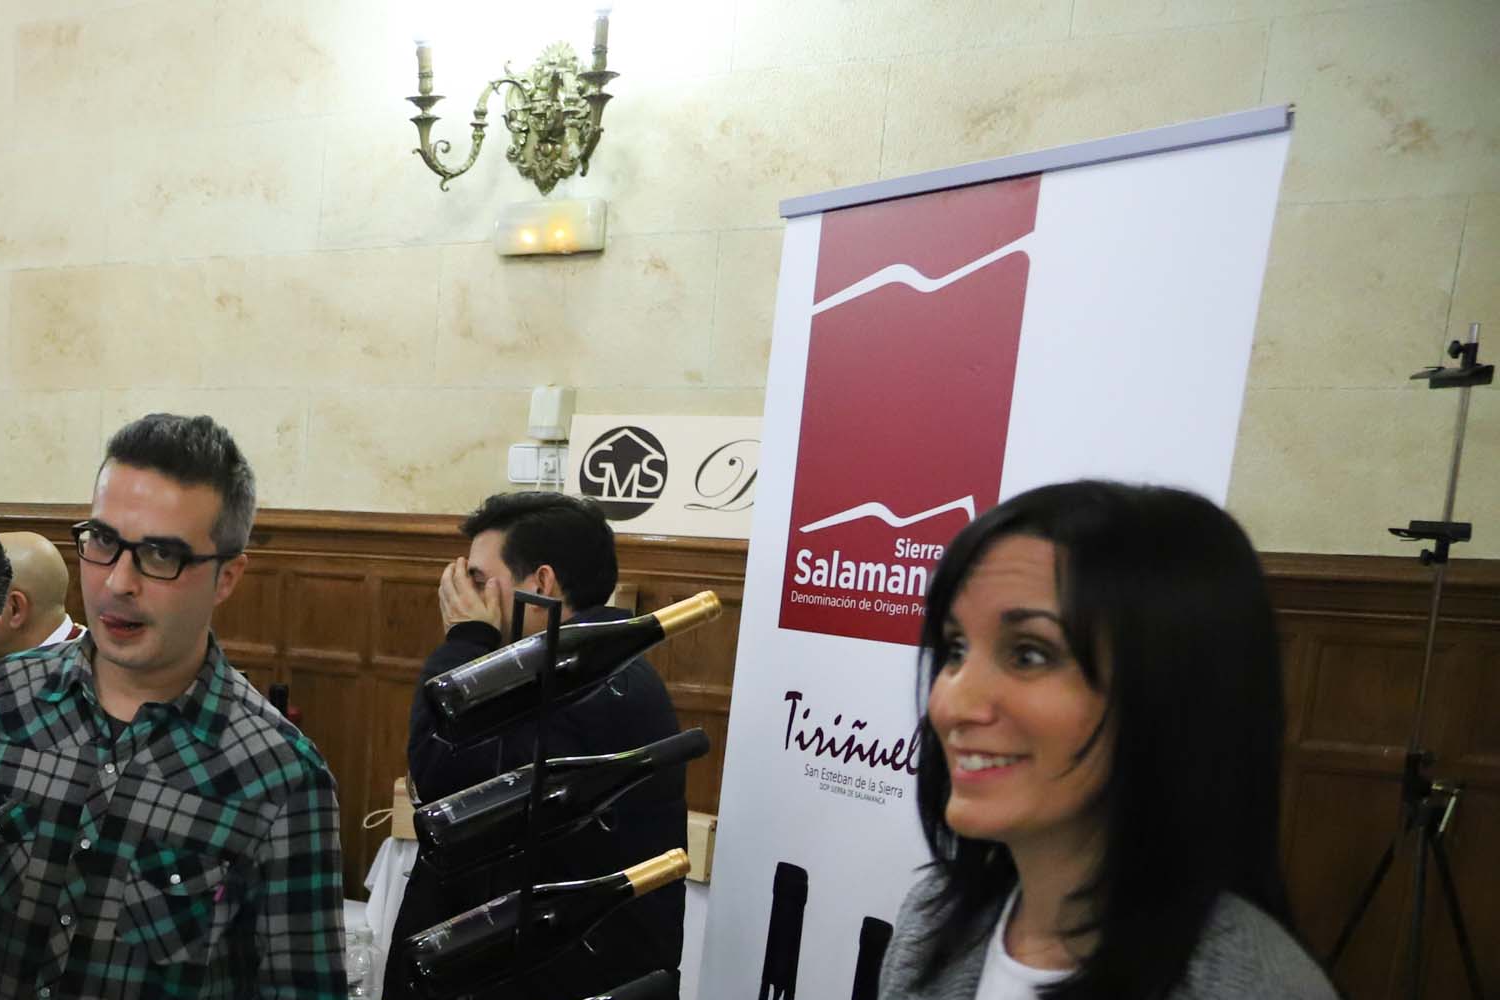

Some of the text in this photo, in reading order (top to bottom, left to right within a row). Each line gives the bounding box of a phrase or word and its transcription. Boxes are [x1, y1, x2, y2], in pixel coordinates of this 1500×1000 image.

[583, 440, 665, 498] GMS
[894, 537, 945, 560] Sierra
[793, 548, 931, 597] Salaman
[790, 590, 856, 610] Denominación
[858, 598, 872, 611] de
[874, 600, 909, 616] Origen
[804, 763, 903, 799] San Esteban de la Sierra
